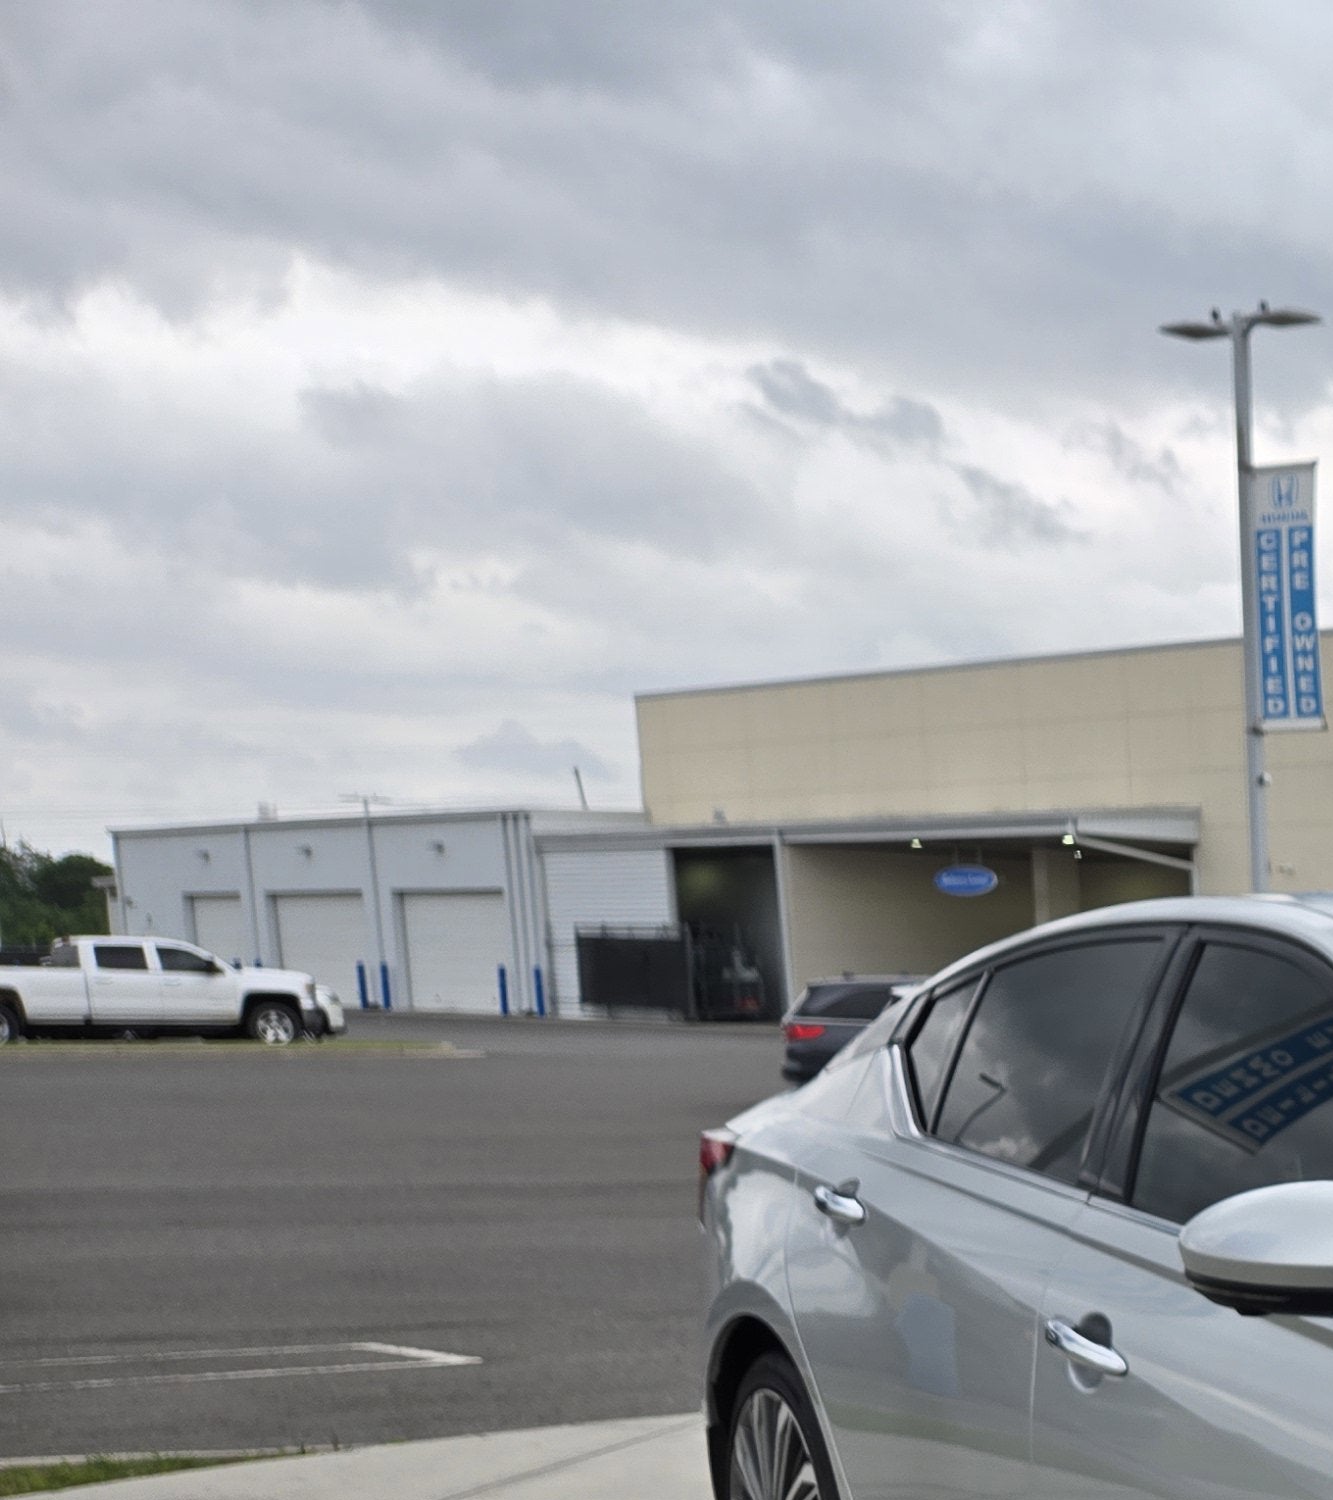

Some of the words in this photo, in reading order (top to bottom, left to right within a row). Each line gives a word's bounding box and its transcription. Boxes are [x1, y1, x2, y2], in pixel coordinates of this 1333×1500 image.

[1291, 528, 1310, 592] PRE
[1258, 531, 1286, 716] CERTIFIED
[1293, 610, 1318, 715] OWNED
